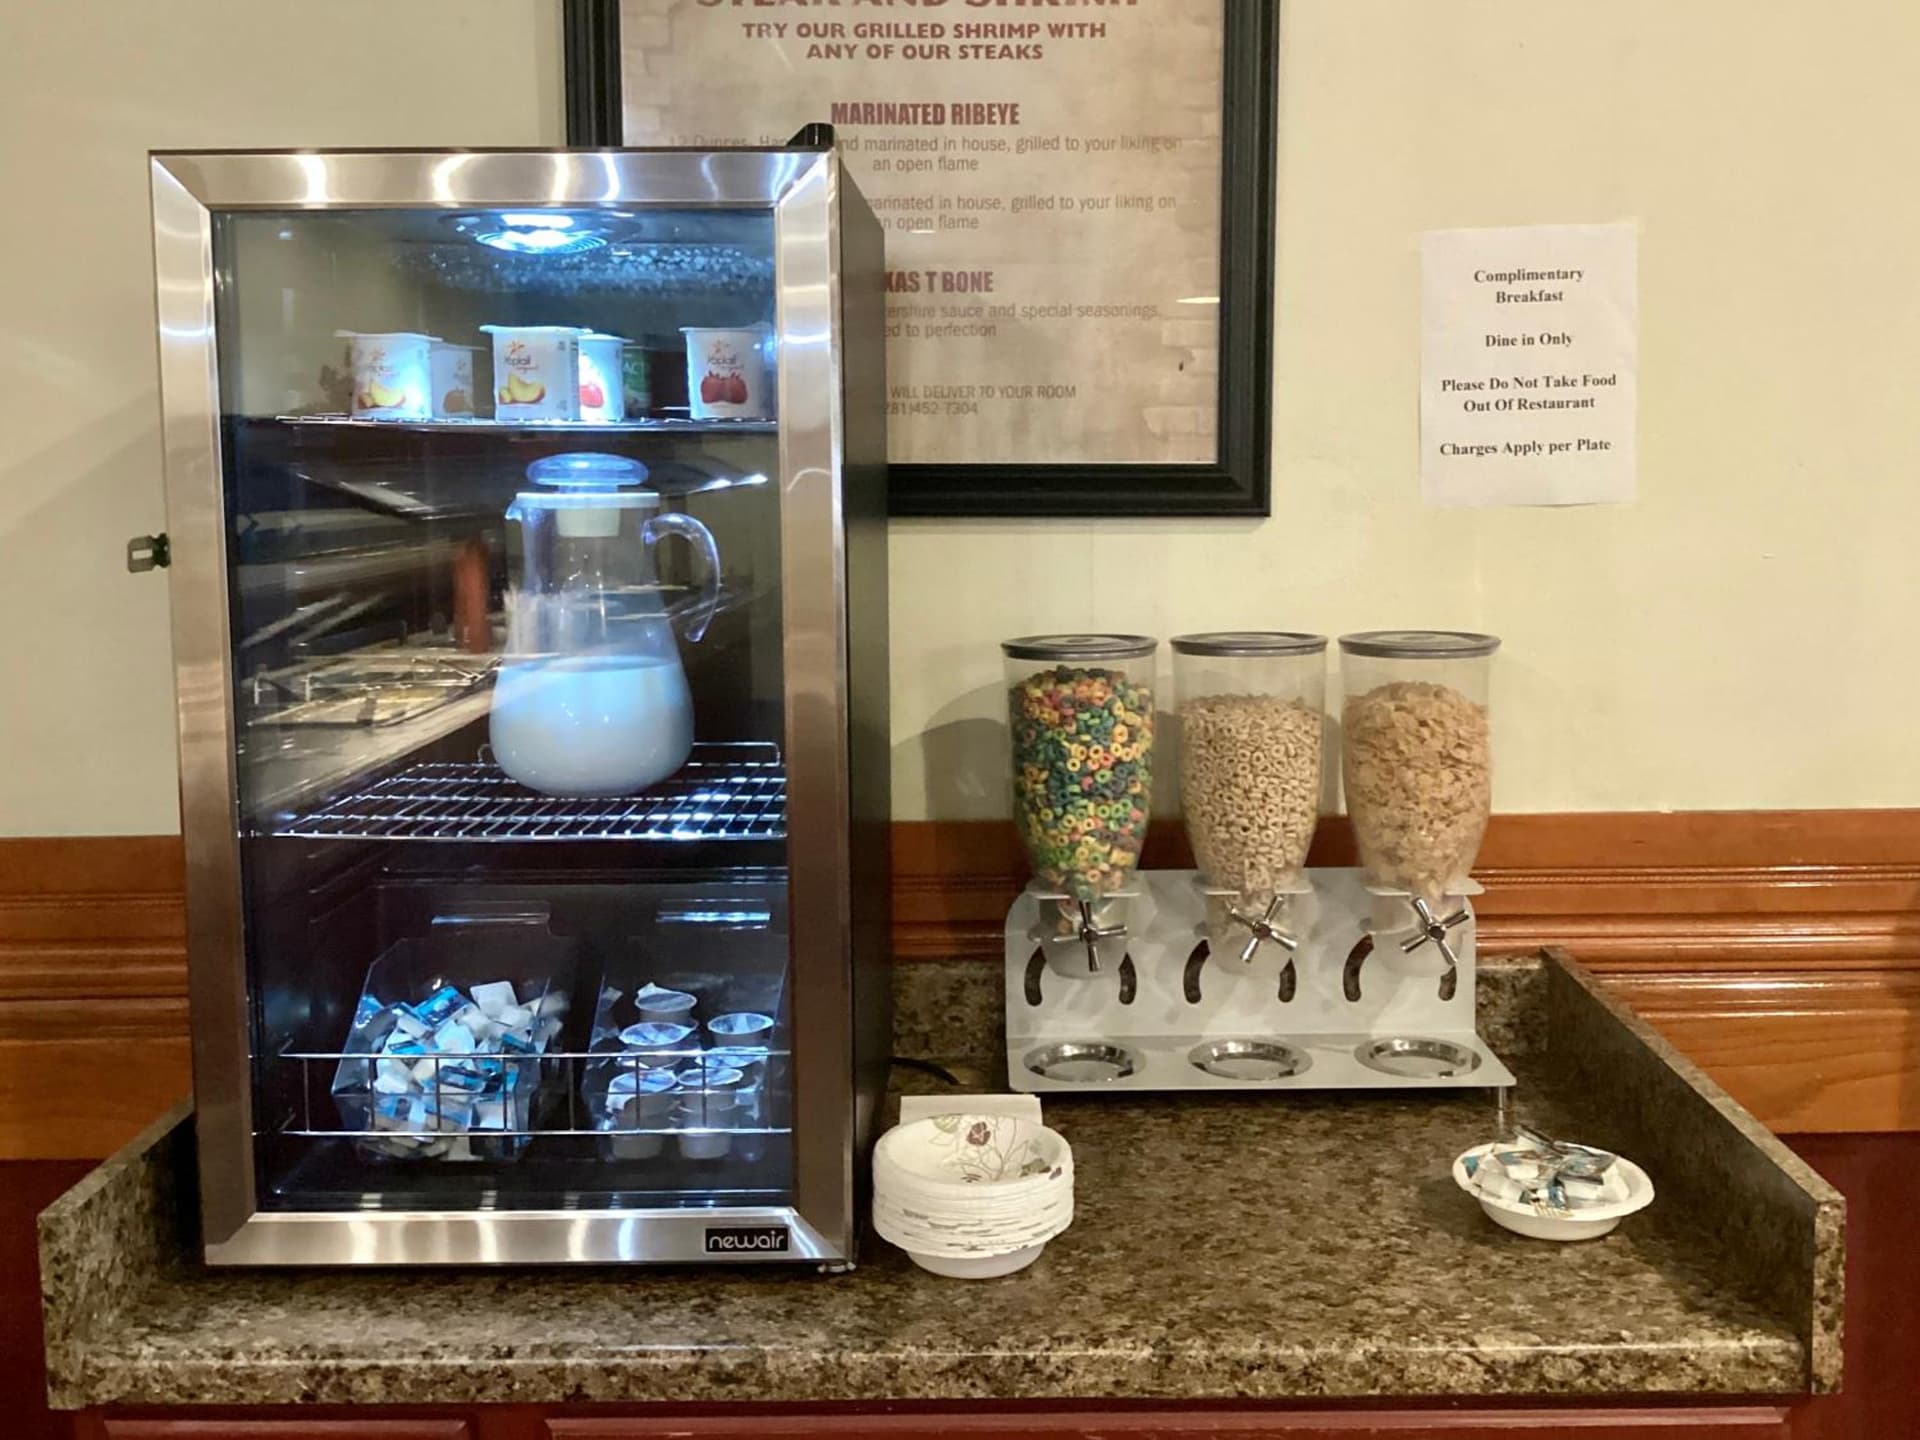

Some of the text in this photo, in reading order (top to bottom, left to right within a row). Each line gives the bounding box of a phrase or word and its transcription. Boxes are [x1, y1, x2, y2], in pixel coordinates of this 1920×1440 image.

[742, 22, 1106, 38] TRY OUR GRILLED SHRIMP WITH
[806, 44, 1043, 59] ANY OF OUR STEAKS
[831, 103, 1020, 125] MARINATED RIBEYE
[864, 135, 938, 152] marinated
[944, 135, 956, 151] in
[1016, 136, 1060, 154] grilled
[1065, 136, 1080, 151] to
[1085, 138, 1117, 154] your
[1121, 135, 1161, 153] liking
[873, 156, 980, 174] an open flame
[939, 195, 952, 210] in
[1011, 194, 1054, 213] grilled
[1060, 195, 1075, 210] to
[1080, 197, 1110, 212] your
[1115, 194, 1153, 212] liking
[1158, 196, 1177, 209] on
[897, 217, 934, 232] open
[938, 213, 980, 230] flame
[884, 271, 994, 293] XAS T BONE
[1474, 268, 1585, 285] Complimentary
[1495, 290, 1564, 304] Breakfast
[940, 306, 984, 319] sauce
[988, 303, 1017, 318] and
[1021, 302, 1073, 320] special
[905, 323, 920, 337] to
[925, 322, 997, 339] perfection
[1485, 332, 1573, 348] Dine in Only
[889, 384, 1077, 399] WILL DELIVER TO YOUR ROOM
[1441, 373, 1617, 392] Please Do Not Take Food
[1463, 397, 1595, 413] Out Of Restaurant
[1439, 438, 1611, 457] Charges Apply per Plate
[708, 1230, 785, 1249] newair
